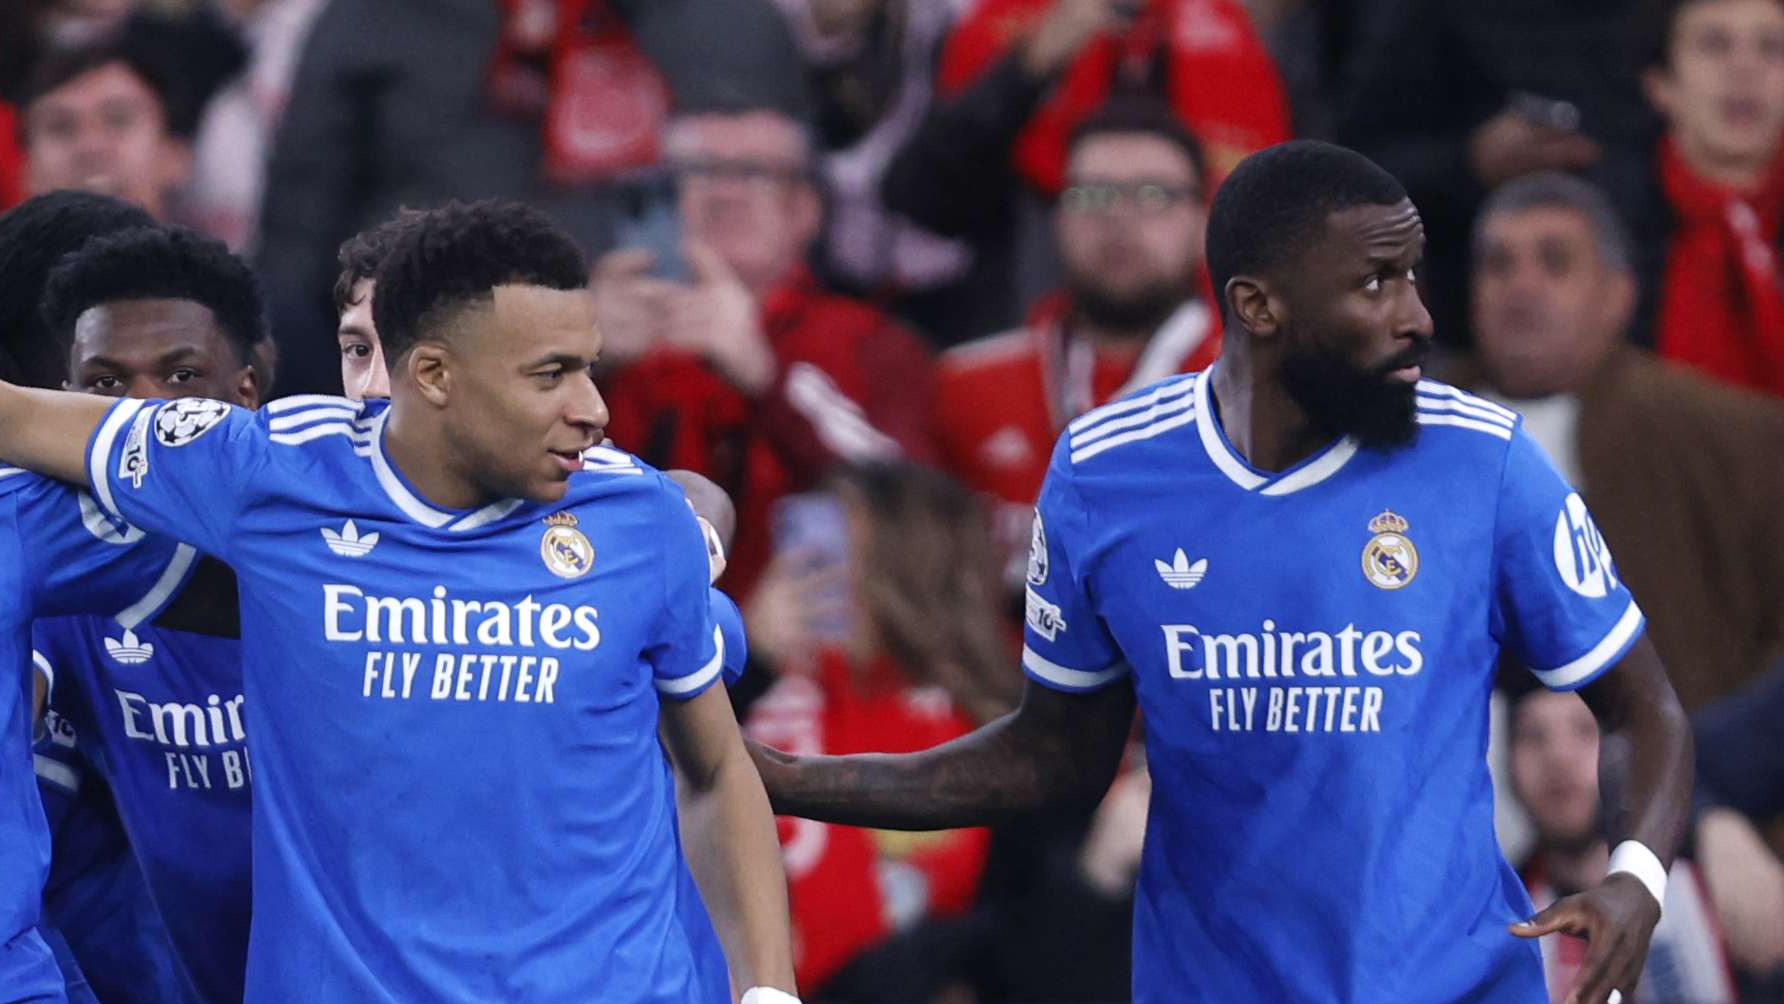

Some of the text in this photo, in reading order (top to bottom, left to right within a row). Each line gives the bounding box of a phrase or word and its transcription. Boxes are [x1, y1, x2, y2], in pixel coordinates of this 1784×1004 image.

[322, 583, 601, 650] Emirates
[1161, 619, 1423, 680] Emirates
[363, 651, 559, 704] FLY BETTER
[114, 689, 246, 746] Emir
[1209, 686, 1383, 733] FLY BETTER
[166, 752, 212, 789] FLY
